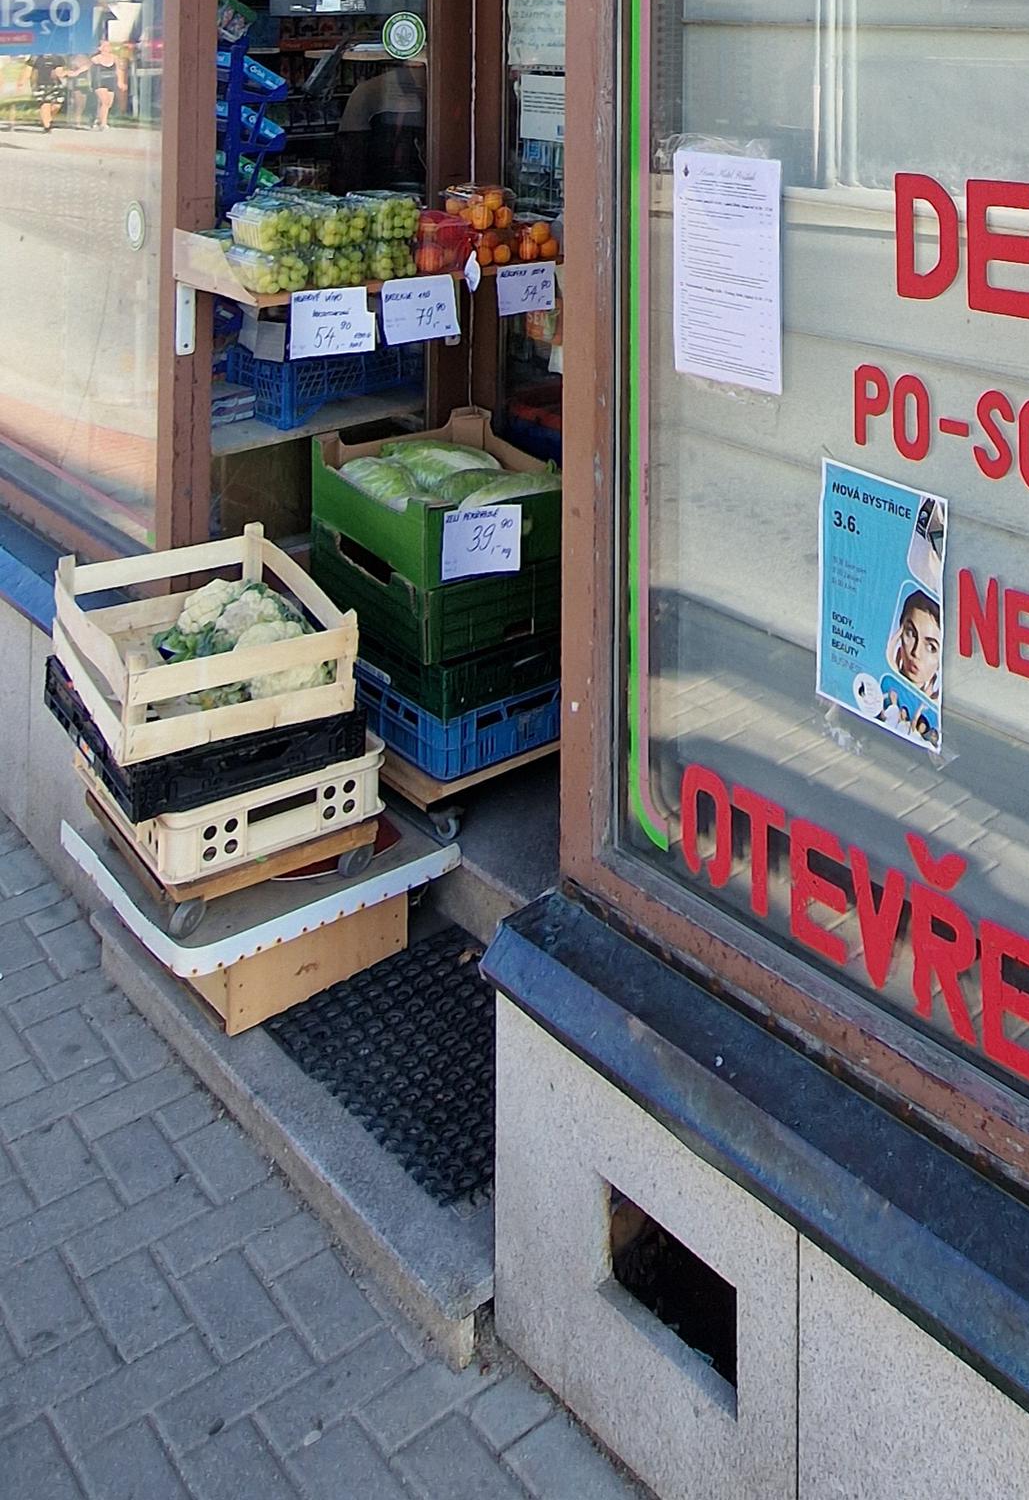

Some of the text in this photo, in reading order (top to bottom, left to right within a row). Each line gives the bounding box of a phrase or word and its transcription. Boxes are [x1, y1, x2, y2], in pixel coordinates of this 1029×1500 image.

[832, 482, 912, 519] NOVÁ BYSTŘICE
[833, 510, 860, 535] 3.6.
[832, 638, 859, 657] BEAUTY
